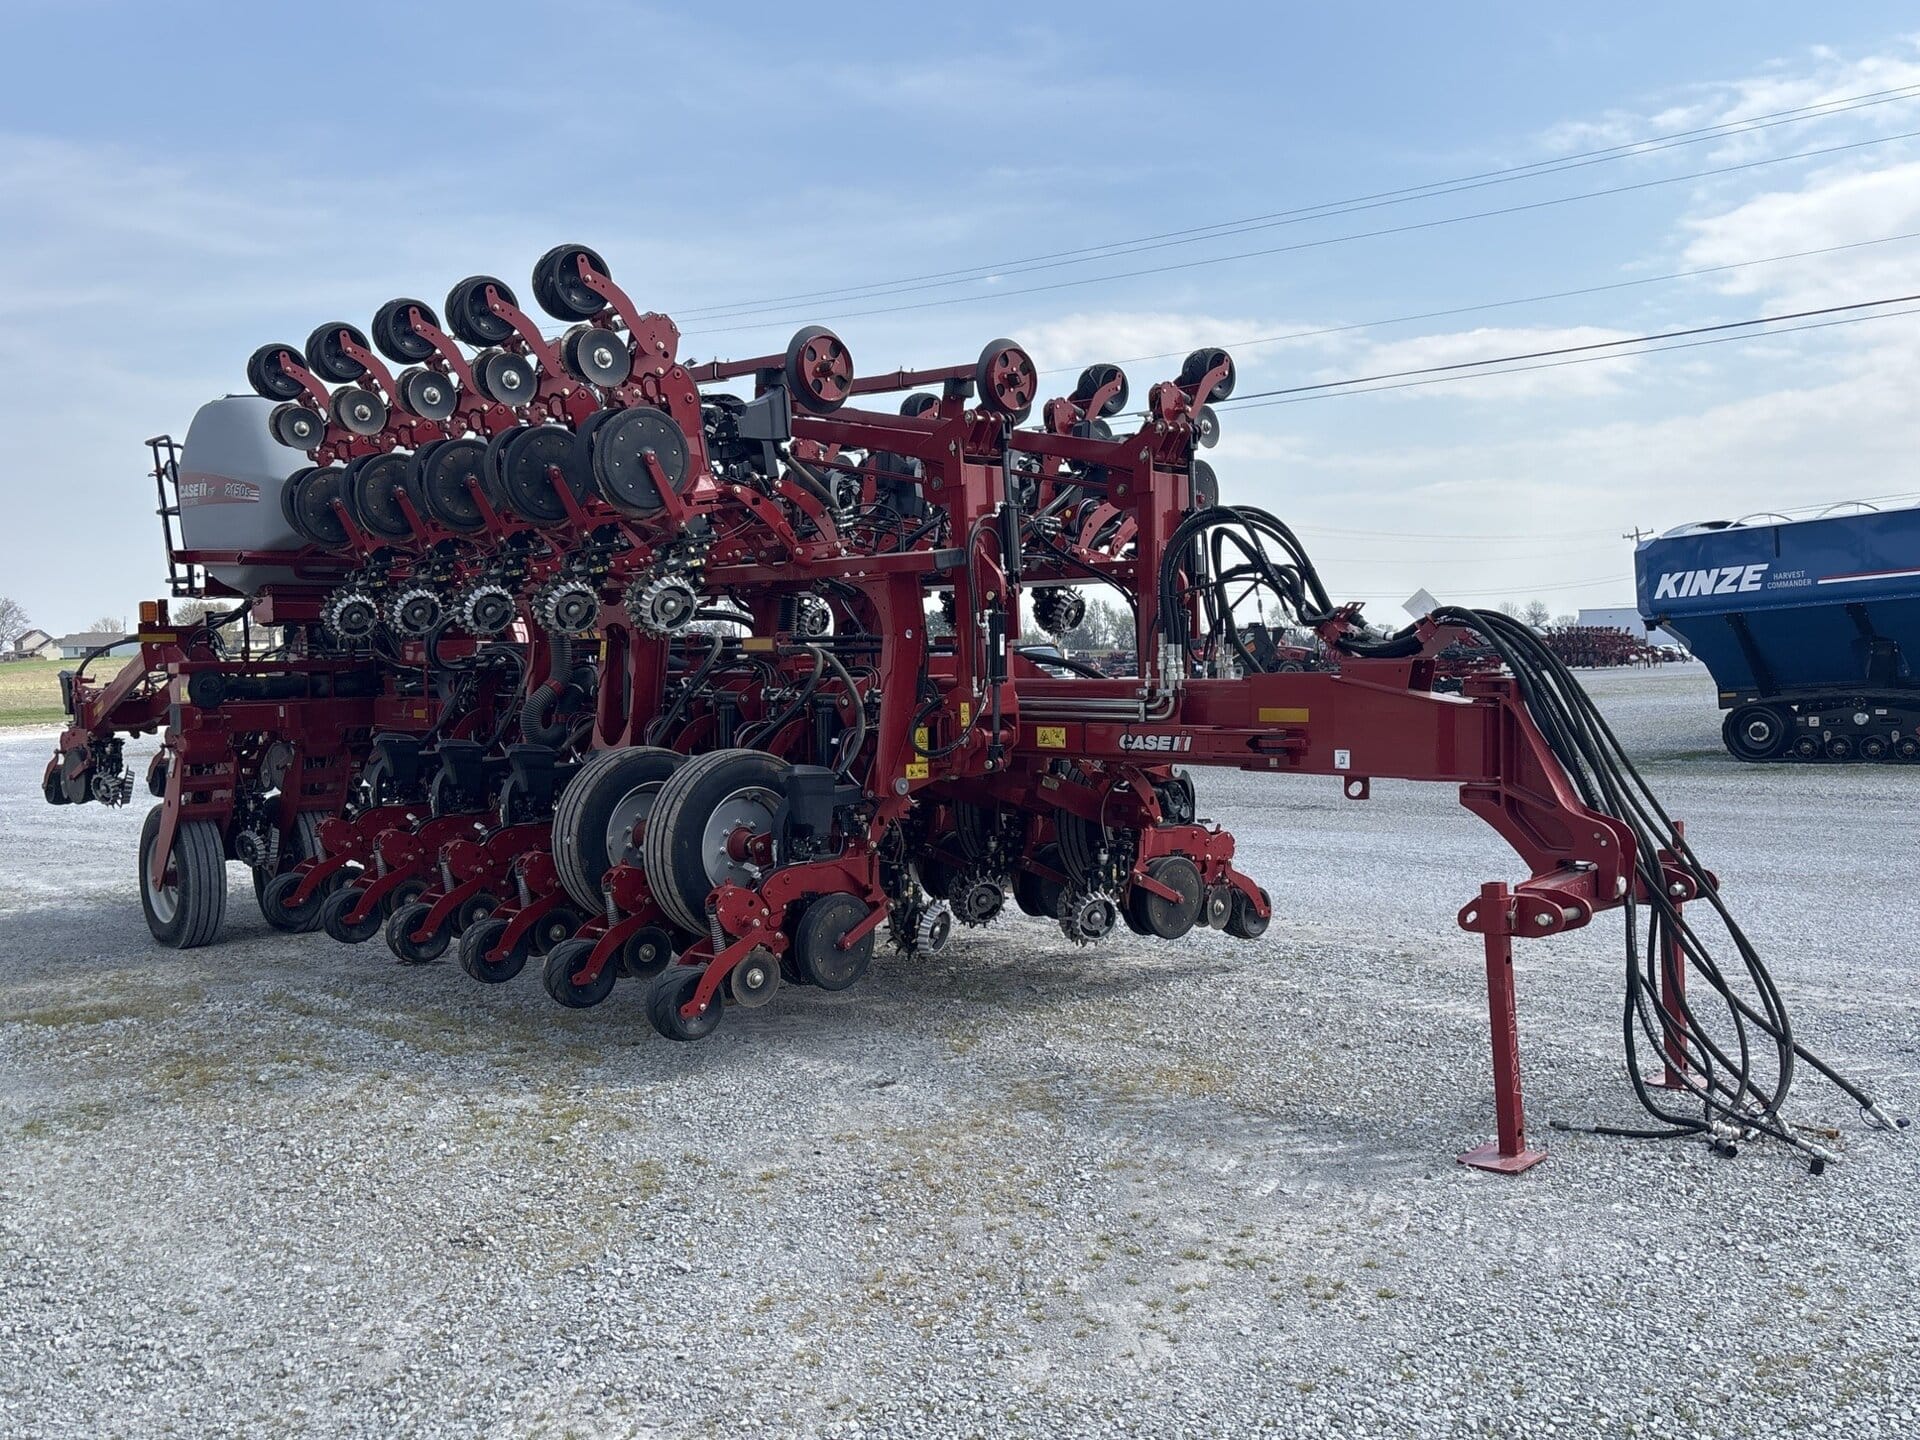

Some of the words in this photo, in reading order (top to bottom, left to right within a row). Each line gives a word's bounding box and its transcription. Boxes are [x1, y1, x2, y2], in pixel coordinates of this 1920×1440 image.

[1654, 563, 1769, 600] KINZE
[1773, 570, 1805, 580] HARVEST
[1767, 578, 1812, 589] COMMANDER
[1119, 734, 1171, 751] CASE
